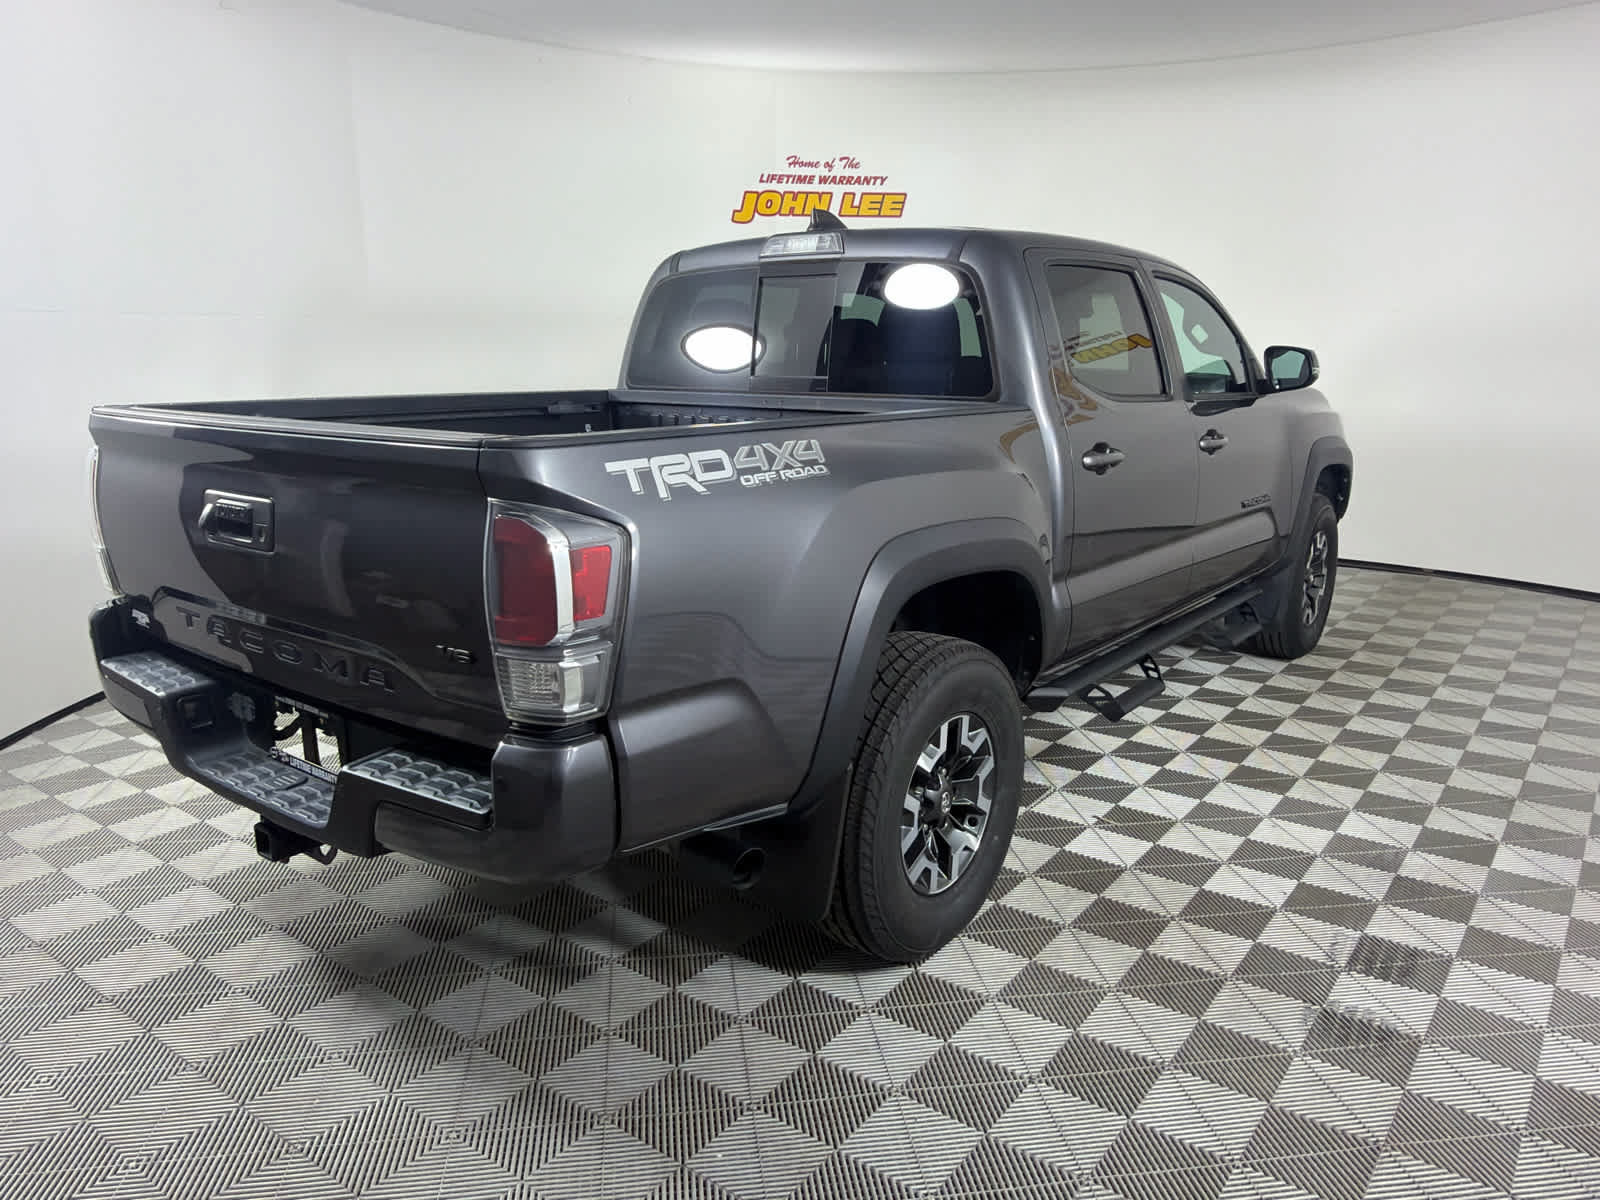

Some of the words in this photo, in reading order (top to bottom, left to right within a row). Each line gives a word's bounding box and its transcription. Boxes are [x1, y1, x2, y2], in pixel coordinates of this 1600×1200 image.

[786, 155, 820, 169] Home
[823, 157, 836, 173] of
[839, 156, 861, 169] The
[759, 173, 815, 185] LIFETIME
[818, 175, 888, 186] WARRANTY
[731, 190, 832, 224] JOHN
[838, 192, 907, 218] LEE
[604, 449, 737, 502] TRD
[740, 470, 777, 487] OFF
[779, 464, 829, 481] ROAD
[176, 606, 395, 695] TACOMA
